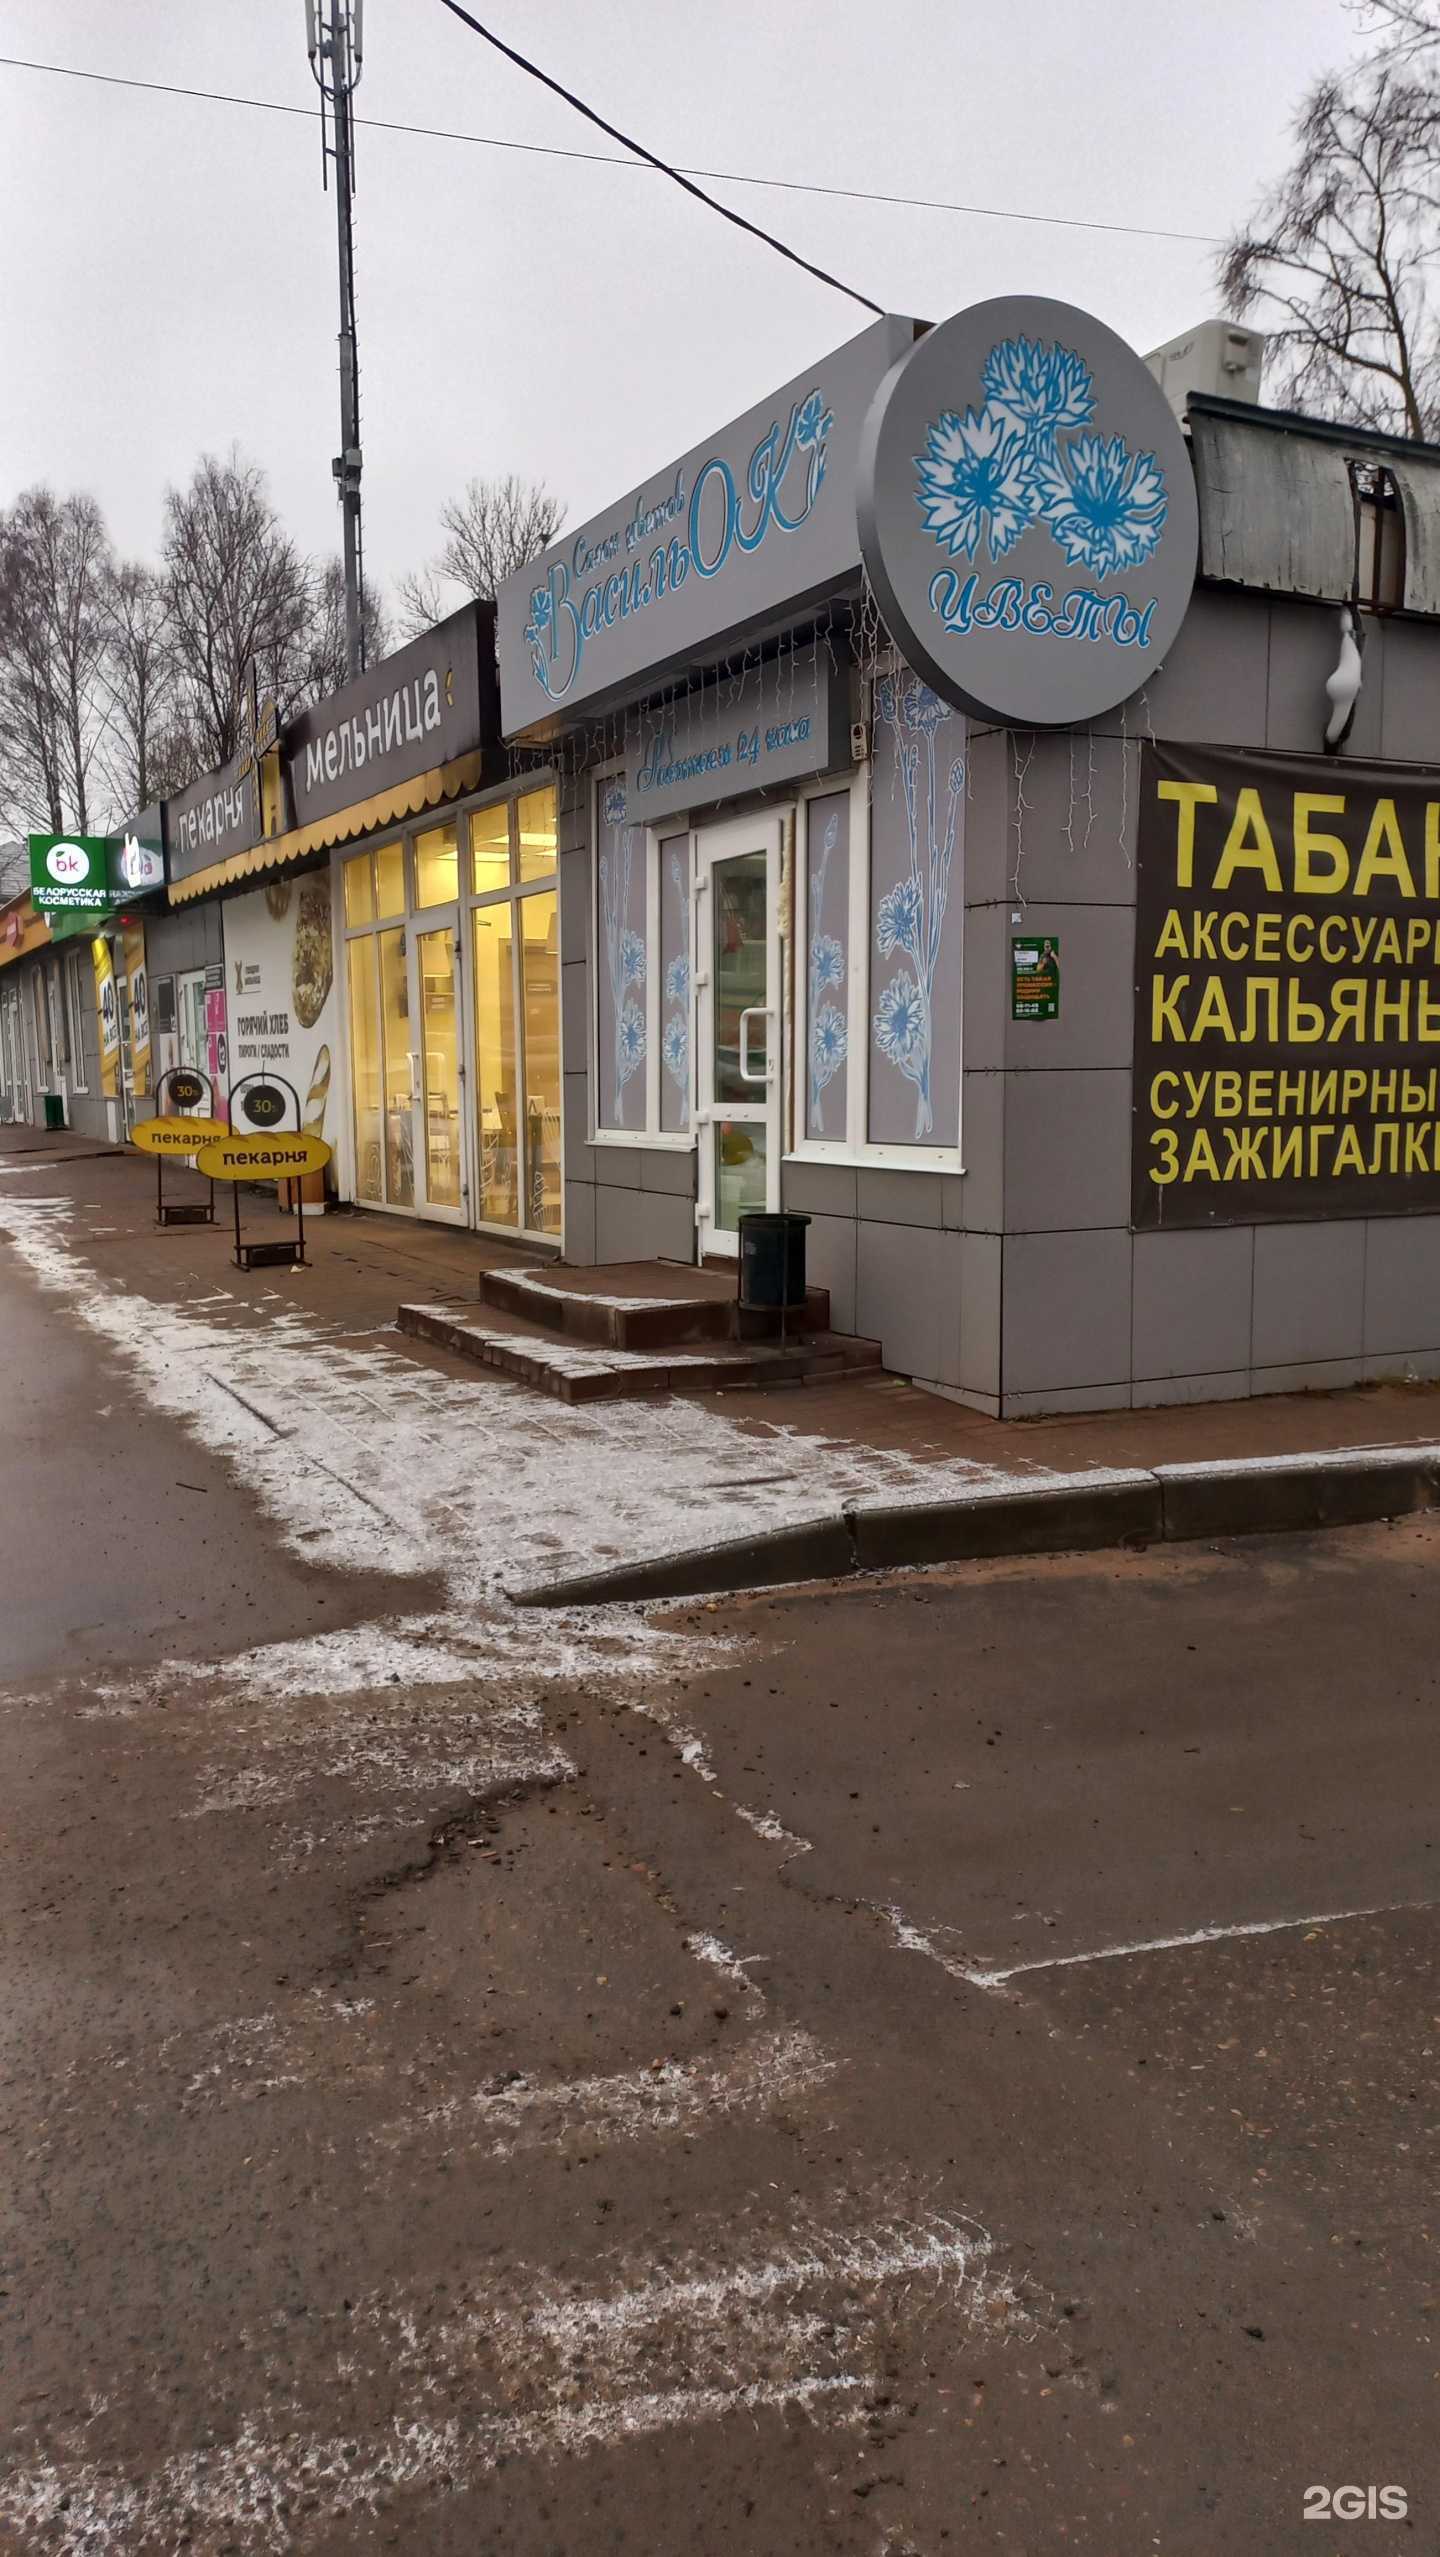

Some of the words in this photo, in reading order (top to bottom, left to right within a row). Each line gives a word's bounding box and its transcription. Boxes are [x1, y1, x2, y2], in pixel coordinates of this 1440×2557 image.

[929, 567, 1158, 648] ЦВЕТЫ
[305, 669, 441, 792] мельница
[737, 726, 760, 765] 24
[177, 783, 244, 853] пекарня
[1157, 780, 1440, 898] ТАБА
[33, 886, 106, 898] БЕЛОРУССКАЯ
[38, 896, 102, 907] КОСМЕТИКА
[1154, 909, 1440, 965] АКСЕССУАР
[237, 1010, 268, 1036] ГОРЯЧИЙ
[269, 1013, 289, 1035] ХЛЕБ
[261, 1043, 289, 1059] СЛАДОСТИ
[223, 1150, 308, 1166] пекарня
[1149, 1121, 1440, 1184] ЗАЖИГАЛК
